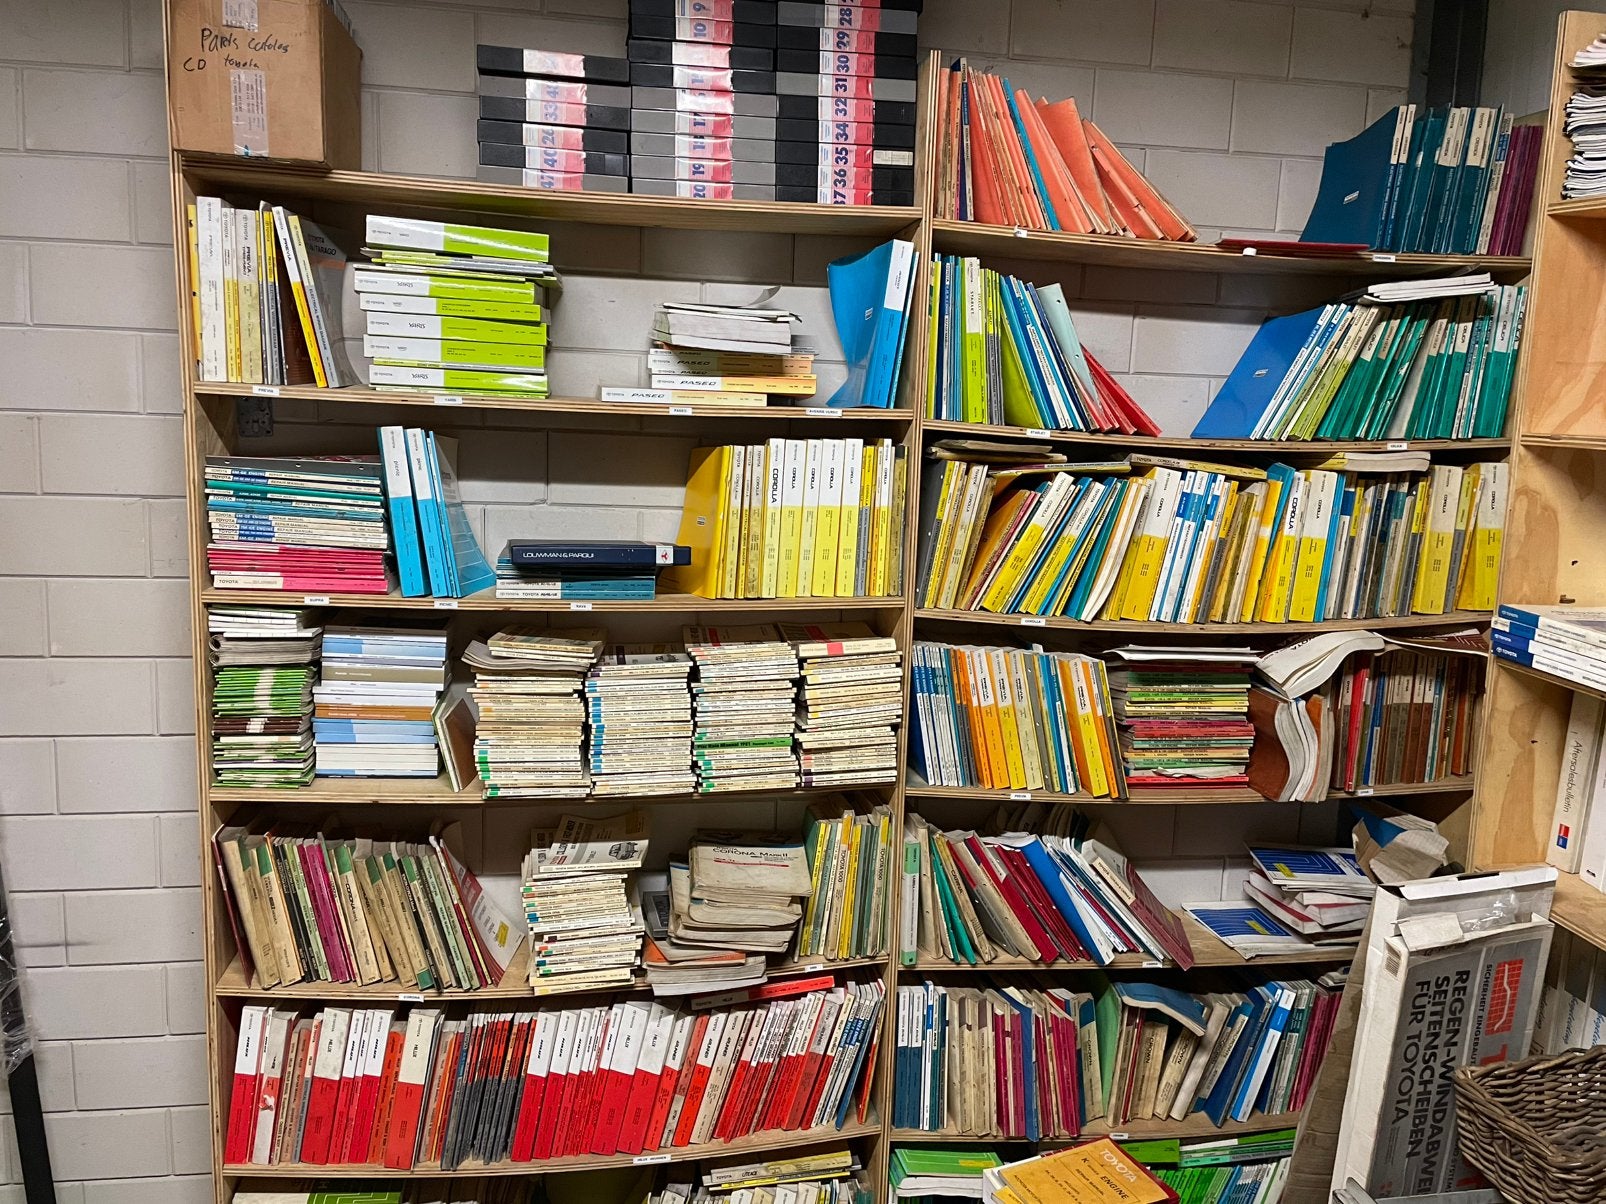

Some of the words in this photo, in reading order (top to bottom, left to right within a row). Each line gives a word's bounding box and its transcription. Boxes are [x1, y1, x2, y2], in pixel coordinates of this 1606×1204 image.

[840, 8, 853, 26] 28
[693, 23, 706, 37] 10
[837, 31, 850, 50] 29
[183, 57, 206, 72] CD
[837, 55, 850, 73] 30
[835, 78, 848, 92] 31
[835, 98, 848, 117] 32
[835, 122, 849, 142] 34
[544, 149, 558, 168] 40
[835, 147, 849, 165] 35
[692, 163, 705, 176] 19
[833, 169, 847, 188] 36
[693, 184, 706, 198] 20
[771, 468, 779, 503] COROLLA
[1157, 497, 1165, 518] COROLLA
[1288, 497, 1298, 530] COROLLA
[713, 847, 755, 855] CORONA
[345, 883, 356, 910] CORONA
[1478, 963, 1492, 1014] SICHERHEIT
[1408, 980, 1431, 1026] FÜR
[1177, 1039, 1190, 1065] CROWN
[1405, 975, 1450, 1159] SEITENSCHEIBEN
[1392, 1030, 1423, 1125] TOYOTA
[1099, 1149, 1137, 1183] TOYOTA
[1100, 1175, 1129, 1200] ENGINE
